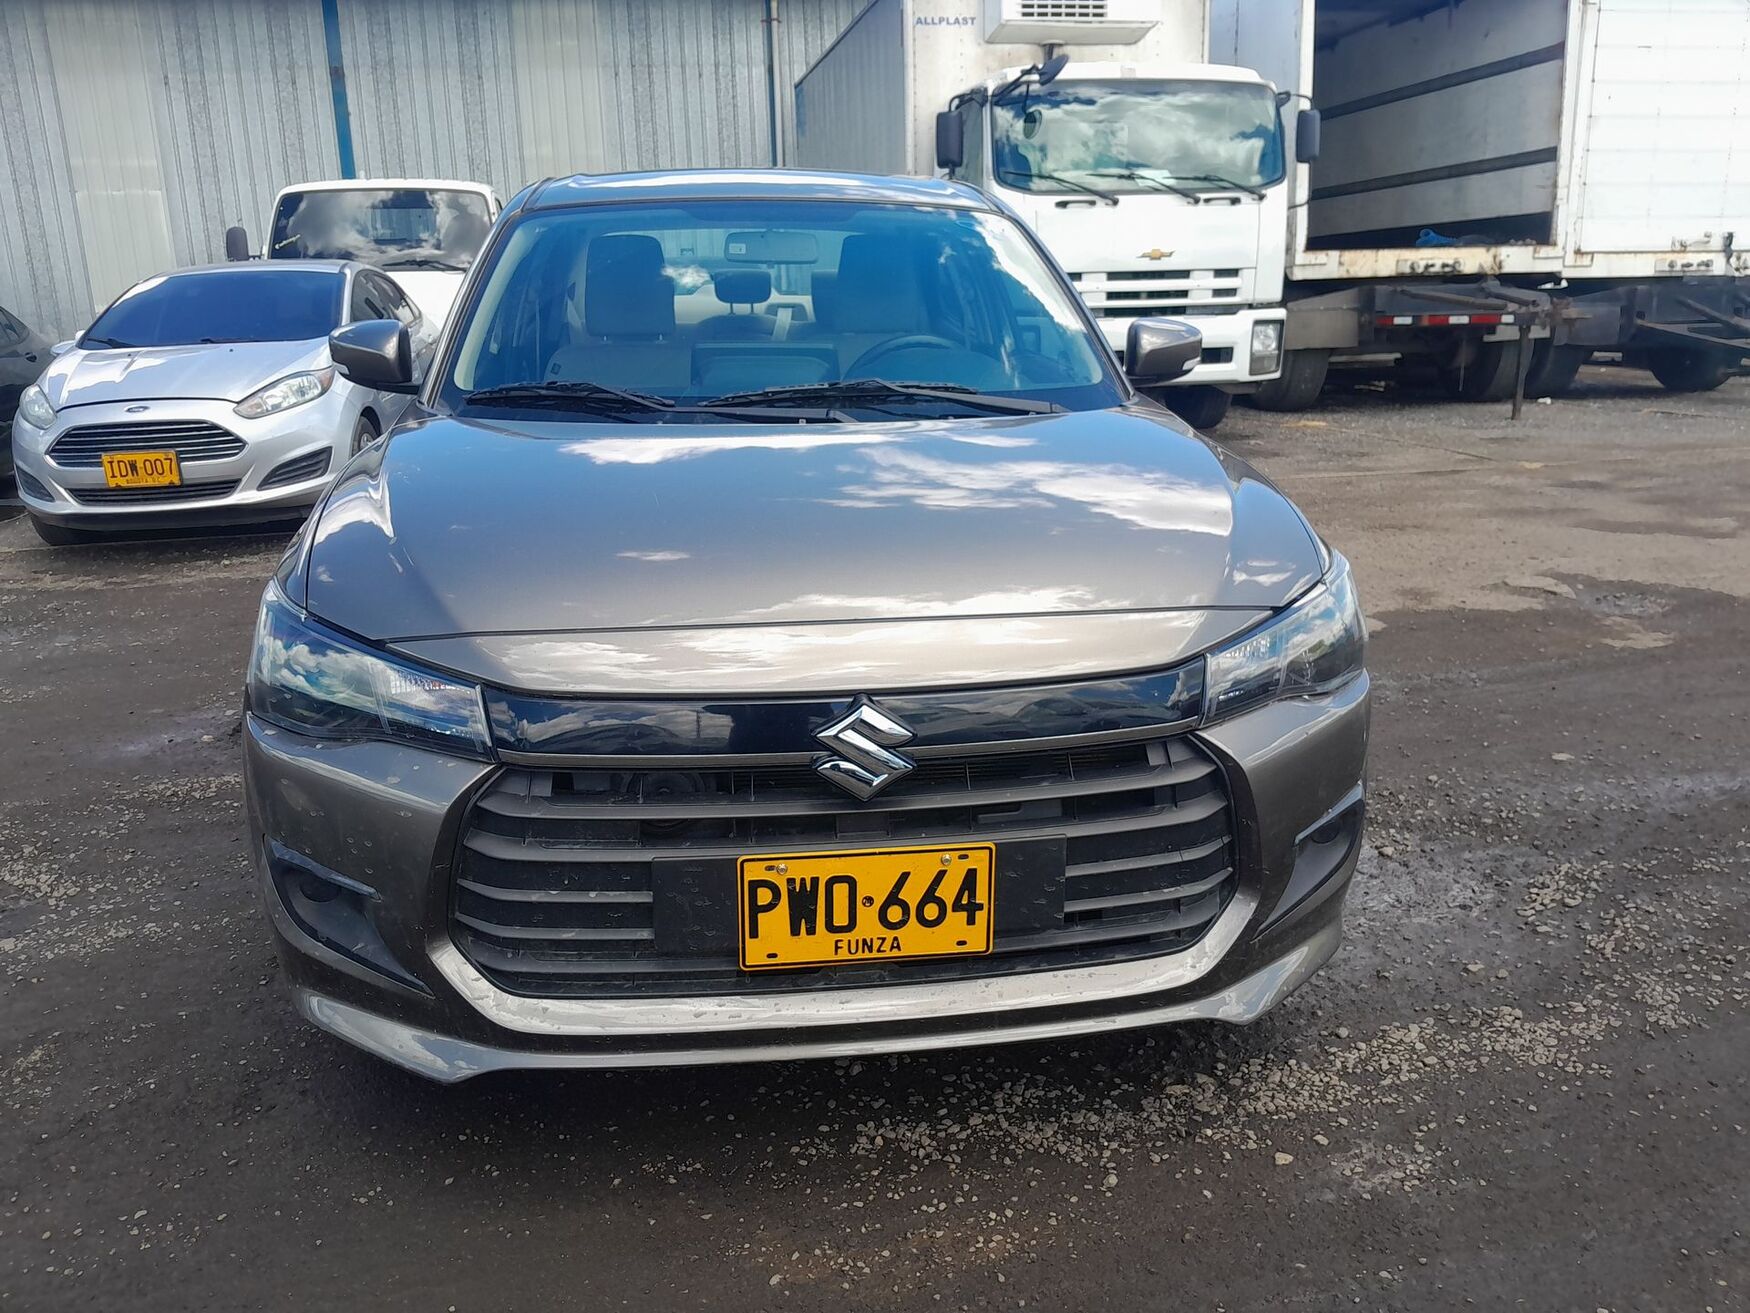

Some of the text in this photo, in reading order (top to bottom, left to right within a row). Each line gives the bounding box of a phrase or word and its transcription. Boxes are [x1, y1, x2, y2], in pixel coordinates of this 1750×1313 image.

[916, 16, 977, 26] ALLPLAST
[143, 457, 173, 476] 007
[834, 936, 902, 956] FUNZA
